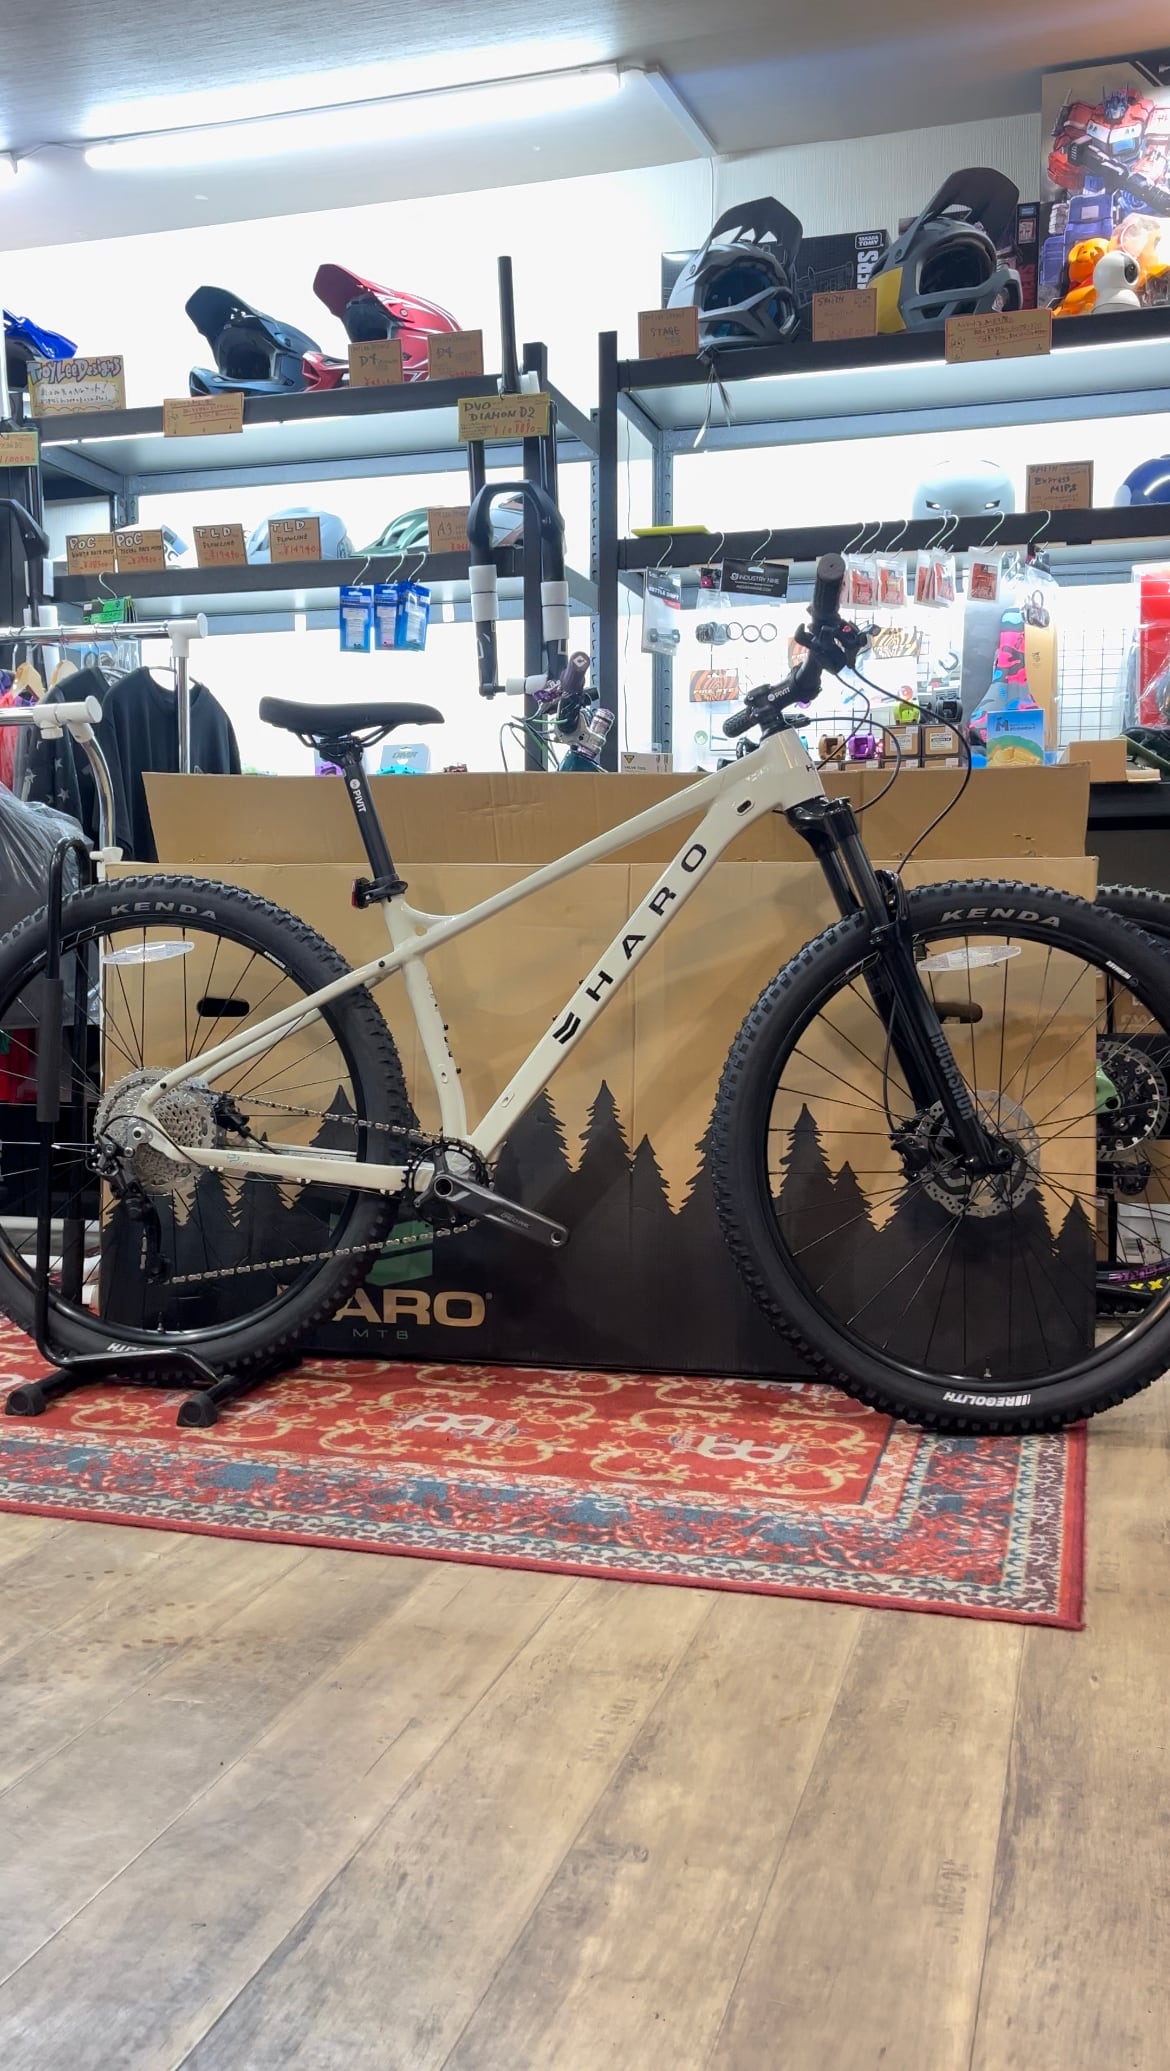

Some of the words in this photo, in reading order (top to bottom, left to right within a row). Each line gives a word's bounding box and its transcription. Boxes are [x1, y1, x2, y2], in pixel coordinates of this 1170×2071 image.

[464, 402, 492, 412] DVO
[196, 527, 232, 539] TLD
[271, 520, 305, 532] TLD
[353, 789, 367, 812] PIVIT
[111, 901, 217, 920] KENDA
[940, 907, 1061, 928] KENDA
[585, 843, 707, 1002] HARO
[353, 1328, 409, 1340] MTB
[942, 1391, 1016, 1408] REGOLITH
